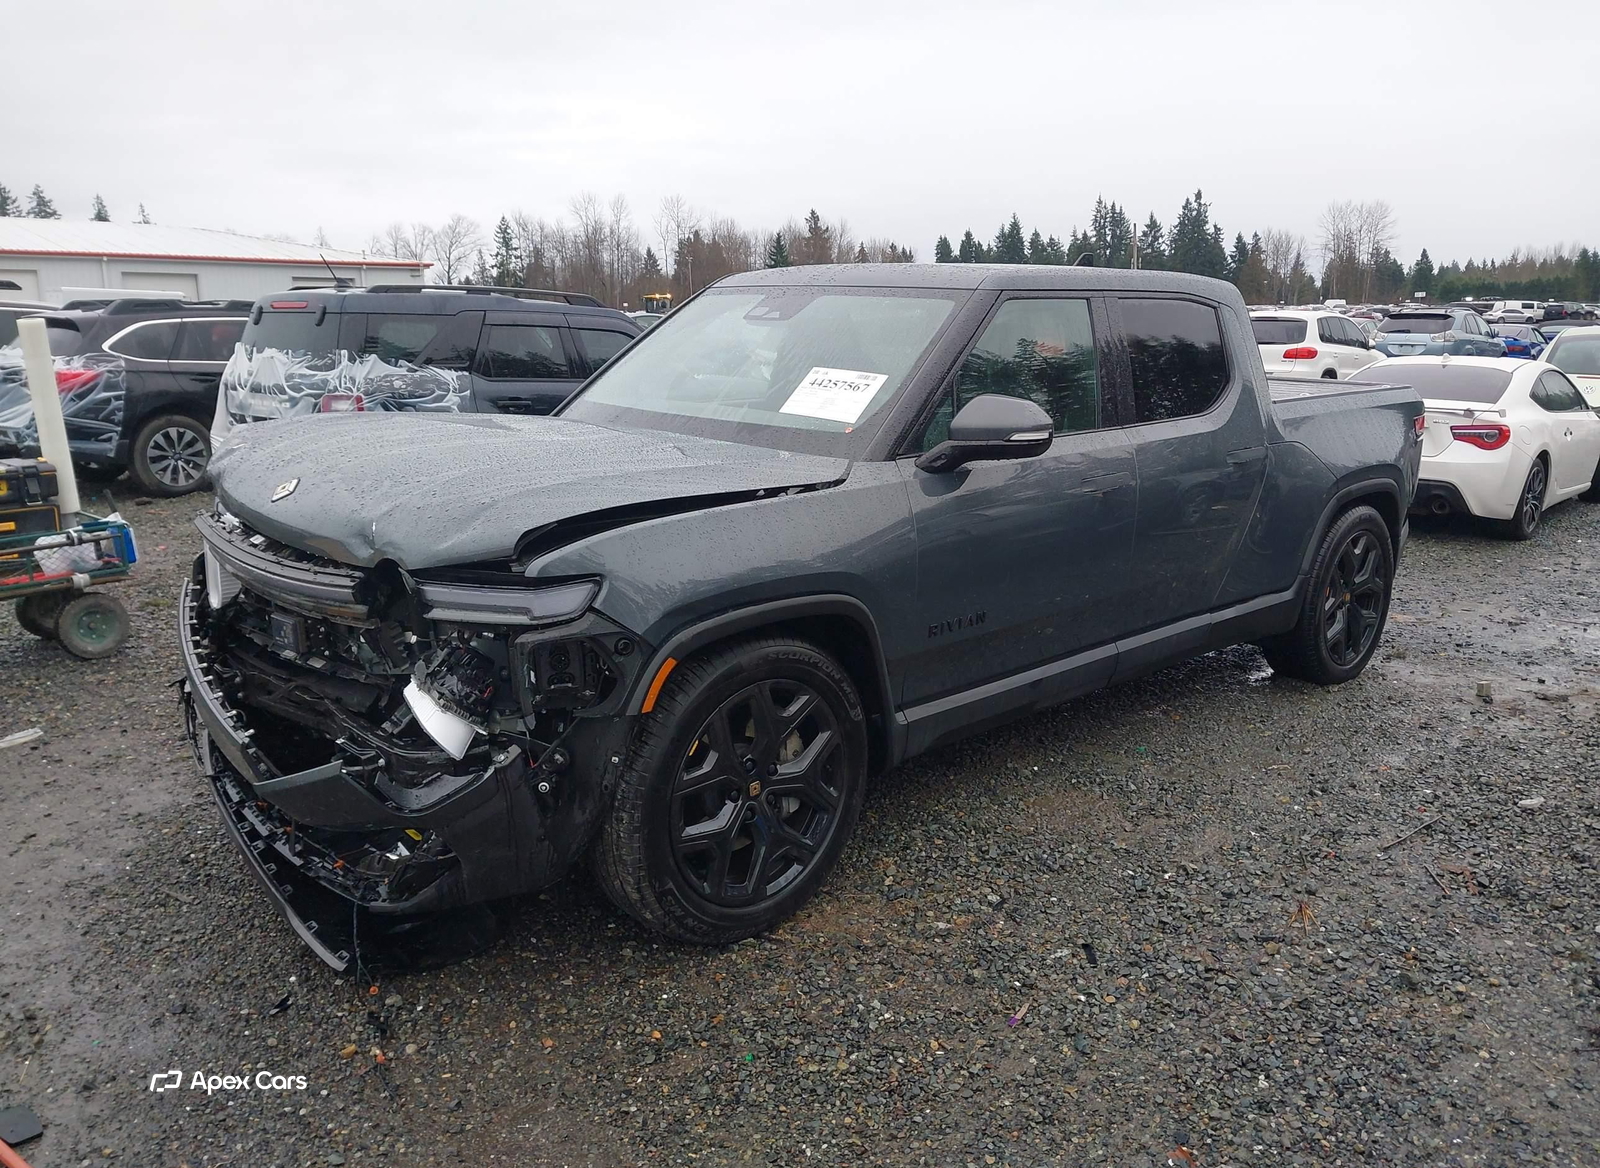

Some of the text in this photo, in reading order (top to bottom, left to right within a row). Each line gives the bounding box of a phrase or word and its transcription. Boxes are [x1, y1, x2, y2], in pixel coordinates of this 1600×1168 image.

[809, 377, 871, 392] 44257567
[928, 610, 987, 638] RIVIAN
[768, 651, 841, 680] SCORPION
